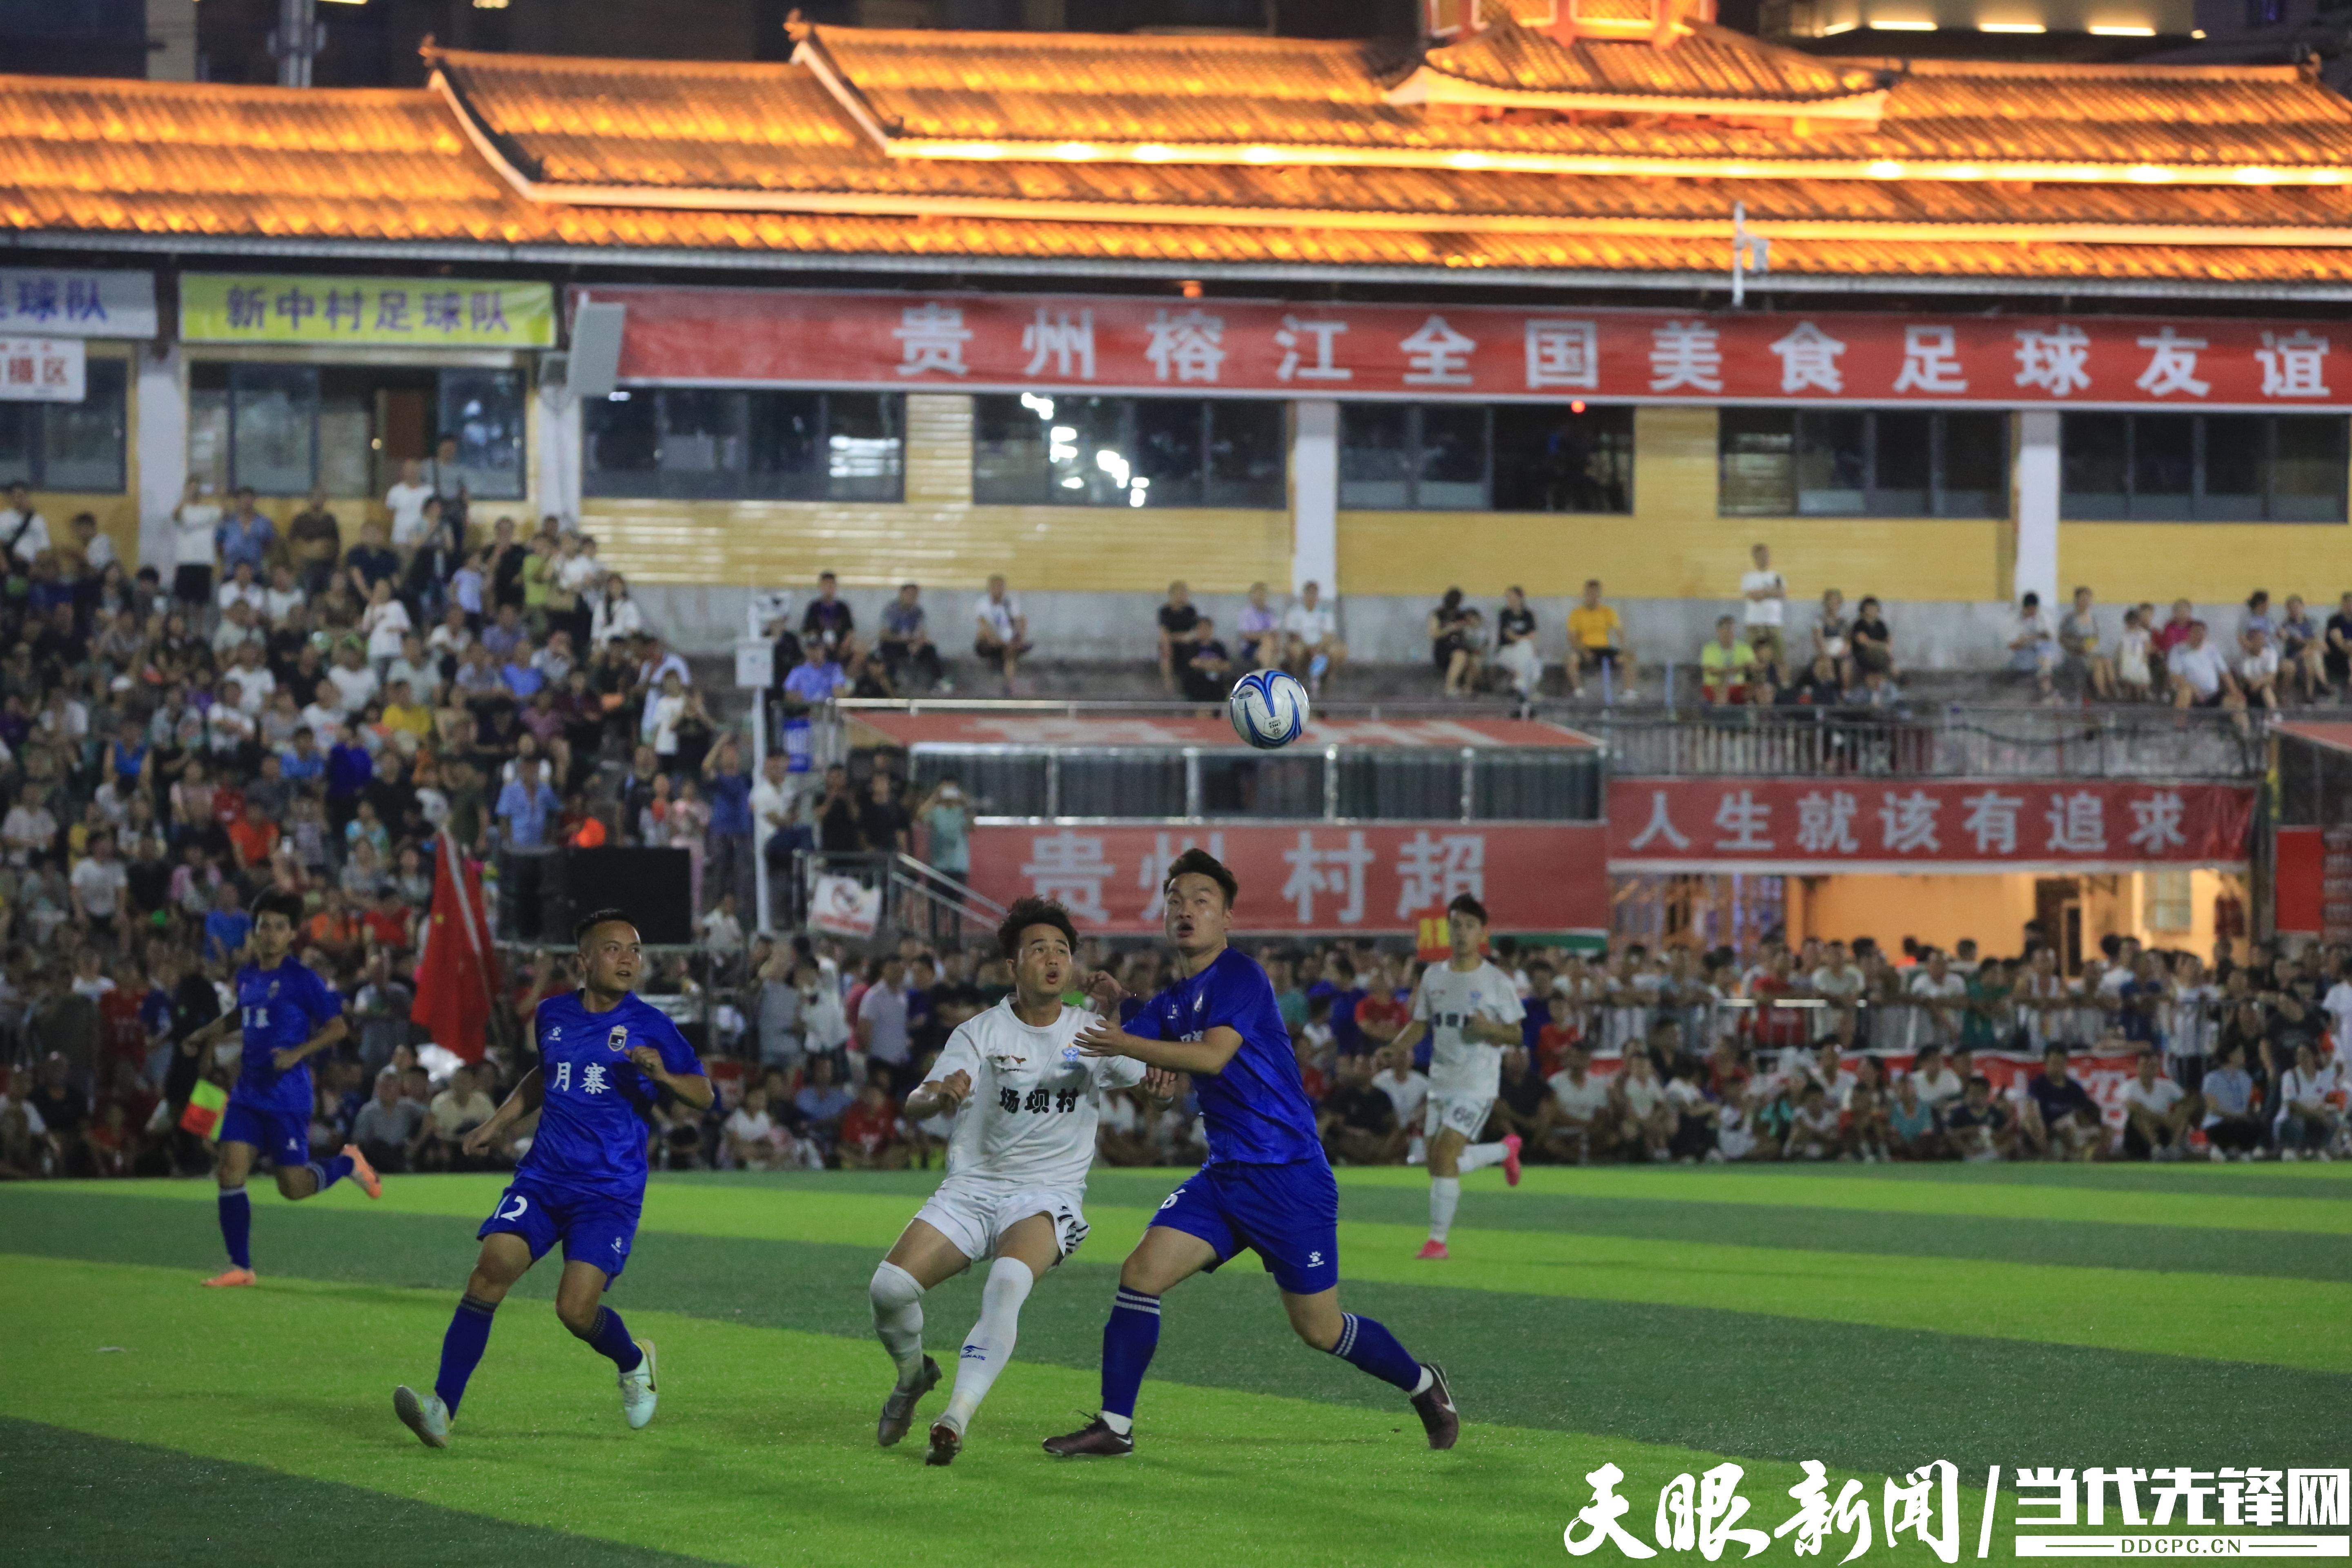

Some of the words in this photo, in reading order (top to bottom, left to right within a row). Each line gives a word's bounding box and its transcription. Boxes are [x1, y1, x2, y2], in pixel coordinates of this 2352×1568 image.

[0, 277, 108, 322] 球队
[226, 286, 509, 332] 新中村足球队
[893, 303, 2331, 399] 贵州榕江全国美食足球友谊
[1629, 789, 2187, 854] 人生就该有追求
[553, 1062, 610, 1094] 月寨
[999, 1086, 1078, 1114] 场坝村
[494, 1195, 528, 1221] 12
